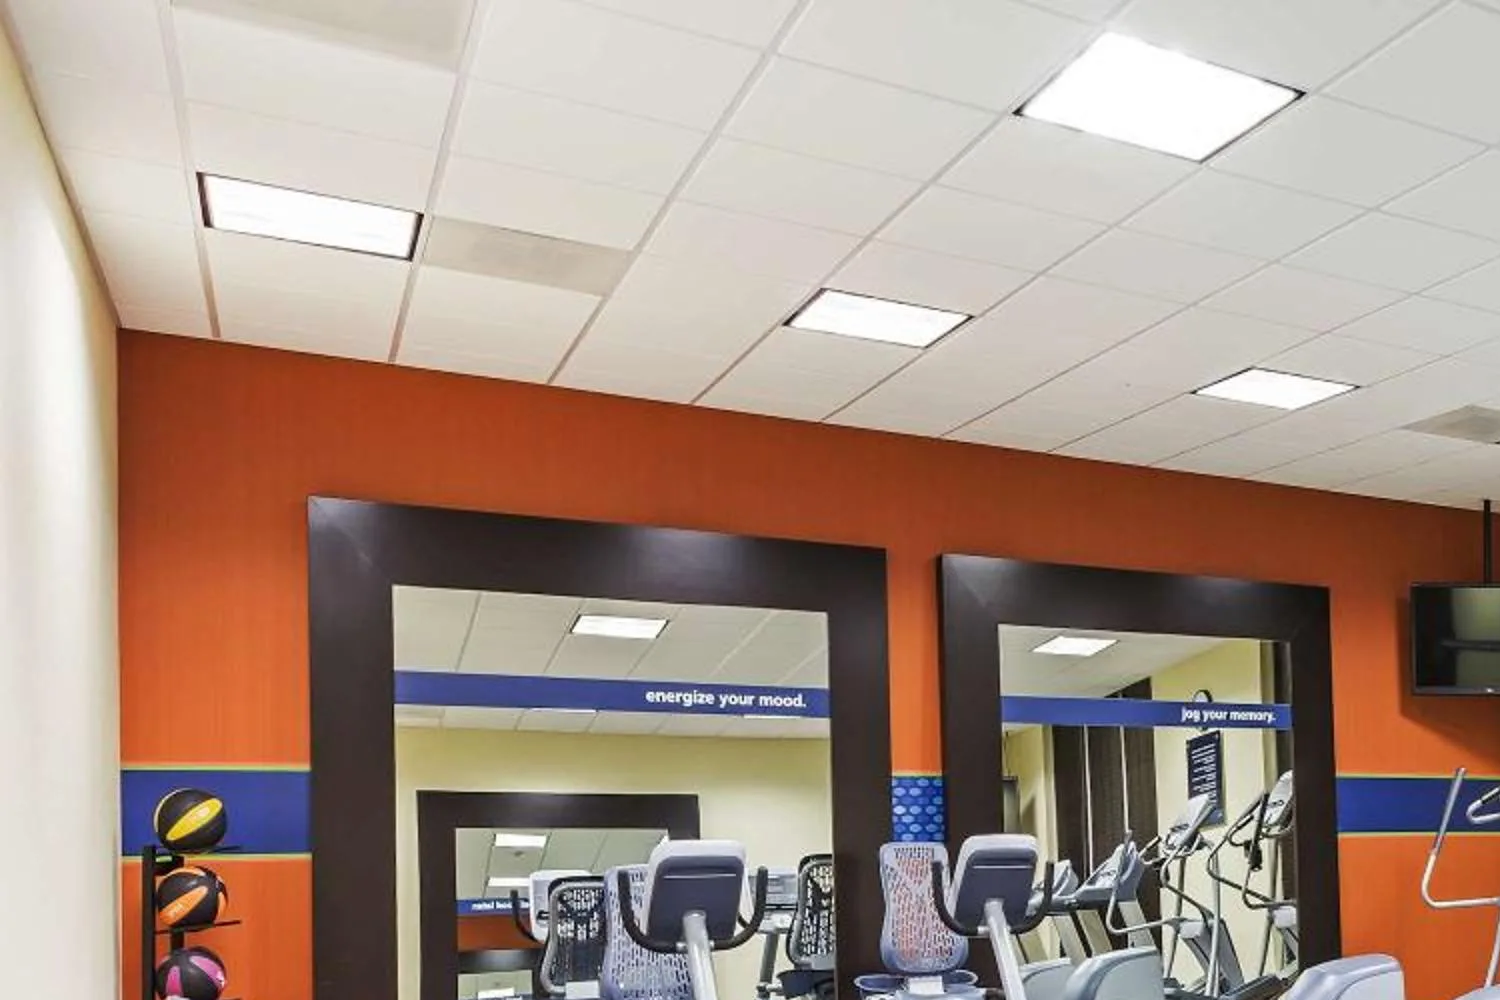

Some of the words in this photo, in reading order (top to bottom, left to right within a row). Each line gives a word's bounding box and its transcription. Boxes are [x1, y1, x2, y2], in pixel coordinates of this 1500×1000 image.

[645, 689, 715, 707] energize
[719, 694, 756, 709] your
[759, 693, 807, 708] mood.
[1181, 706, 1201, 723] jog
[1202, 710, 1228, 723] your
[1229, 711, 1276, 724] memory.
